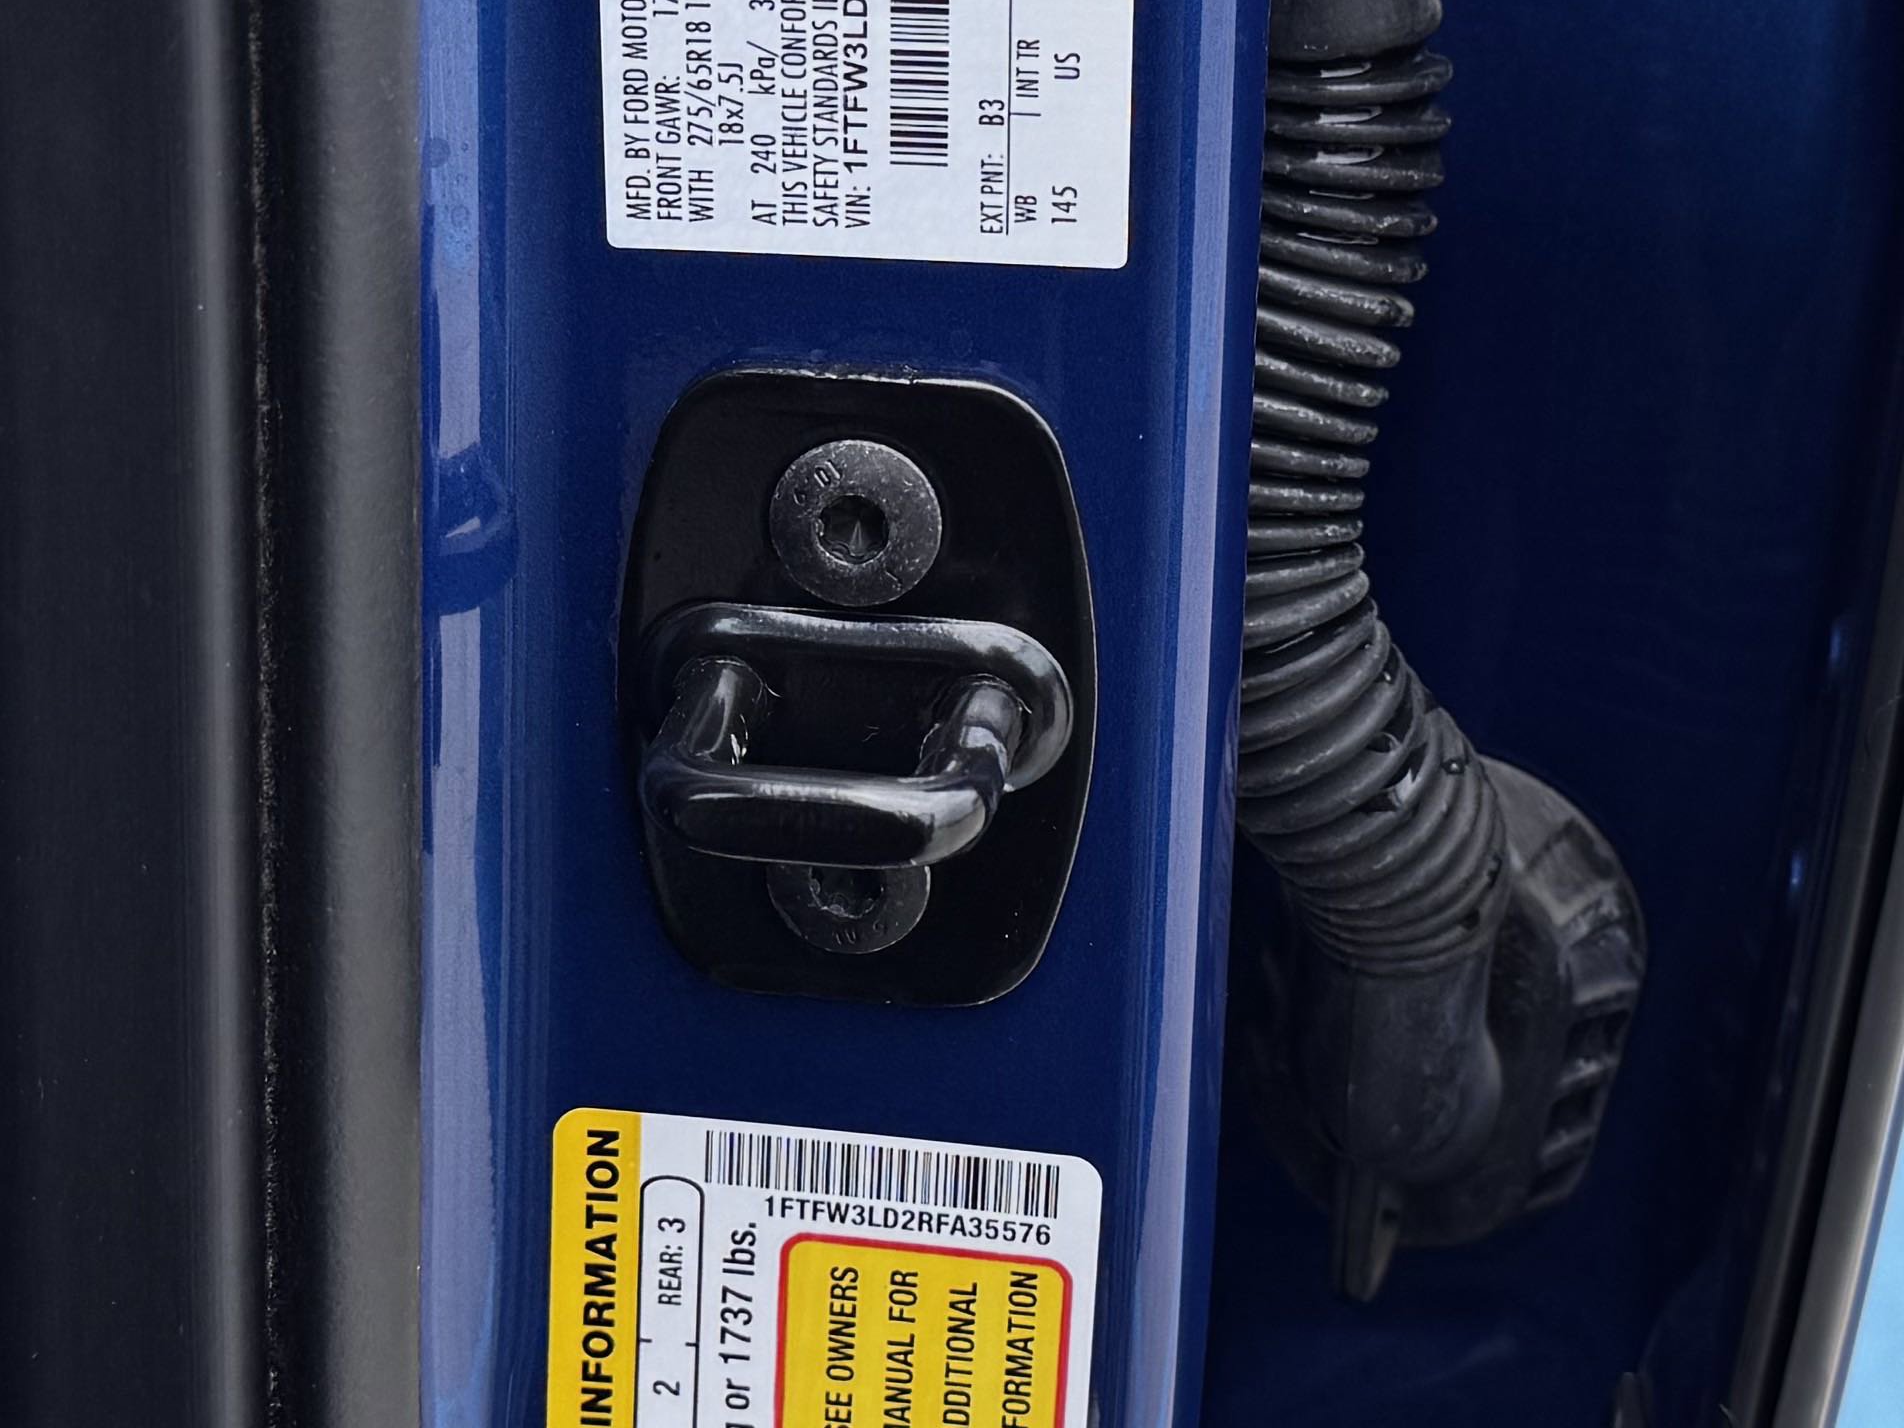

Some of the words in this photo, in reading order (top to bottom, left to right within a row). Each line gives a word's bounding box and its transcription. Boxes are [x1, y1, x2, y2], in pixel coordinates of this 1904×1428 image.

[746, 41, 778, 95] kPa/
[1017, 39, 1040, 59] TR
[1054, 53, 1080, 80] US
[622, 68, 649, 124] FORD
[683, 21, 716, 147] 275/65R18
[717, 62, 745, 146] 18x7.5J
[812, 20, 838, 146] STANDARDS
[1015, 69, 1040, 98] INT
[654, 75, 681, 144] GAWR:
[781, 88, 808, 172] VEHICLE
[979, 99, 1005, 126] B3
[624, 133, 650, 159] BY
[750, 134, 777, 174] 240
[625, 169, 651, 220] MFD.
[656, 152, 682, 220] FRONT
[688, 169, 714, 222] WITH
[812, 154, 839, 227] SAFETY
[980, 154, 1005, 194] PNT:
[751, 199, 777, 226] AT
[782, 181, 808, 226] THIS
[844, 185, 871, 228] VIN:
[980, 202, 1004, 234] EXT
[1014, 195, 1037, 223] WB
[1051, 185, 1078, 224] 145
[764, 1195, 1051, 1246] 1FTFW3LD2RFA35576
[722, 1222, 757, 1276] lbs.
[580, 1130, 620, 1427] INFORMATION
[658, 1245, 683, 1306] REAR:
[888, 1270, 918, 1324] FOR
[718, 1286, 754, 1365] 1737
[825, 1266, 859, 1381] OWNERS
[724, 1378, 749, 1410] or
